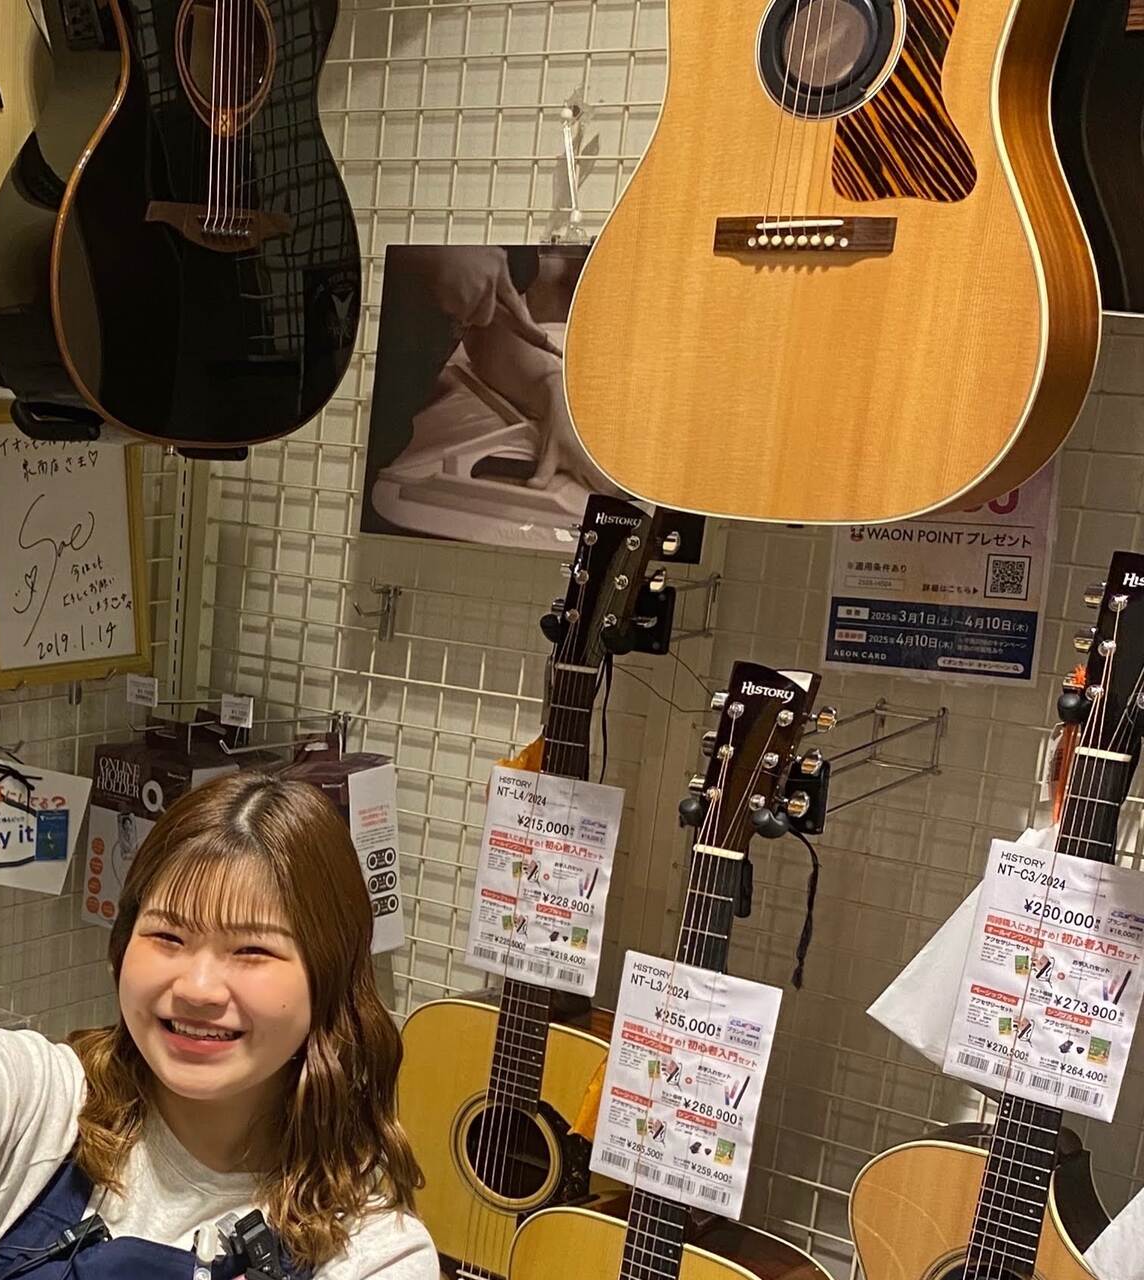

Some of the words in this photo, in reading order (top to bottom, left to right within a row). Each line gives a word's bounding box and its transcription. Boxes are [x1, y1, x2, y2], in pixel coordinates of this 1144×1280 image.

[596, 512, 642, 528] HISTORY
[867, 528, 914, 542] WAON
[917, 531, 963, 545] POINT
[967, 533, 1032, 549] プレゼント
[38, 621, 117, 660] 2019.1.14
[861, 652, 887, 660] CARD
[741, 681, 794, 703] HISTORY
[100, 756, 140, 777] ONLINE
[97, 776, 139, 799] HOLDER
[499, 776, 532, 789] HISTORY
[497, 786, 547, 806] NT-L4/2024
[19, 825, 34, 843] it
[517, 814, 569, 836] ¥215,000
[1001, 851, 1046, 868] HISTORY
[997, 863, 1066, 890] NT-C3/2024
[542, 892, 589, 913] ¥228,900
[1024, 899, 1094, 929] ¥260,000
[633, 963, 672, 978] HISTORY
[630, 973, 689, 1000] NT-L3/2024
[1054, 994, 1117, 1021] ¥273,900
[655, 1007, 716, 1037] ¥255,000
[1060, 1063, 1103, 1082] ¥264,400
[684, 1098, 738, 1125] ¥268,900
[691, 1162, 729, 1182] ¥259,400
